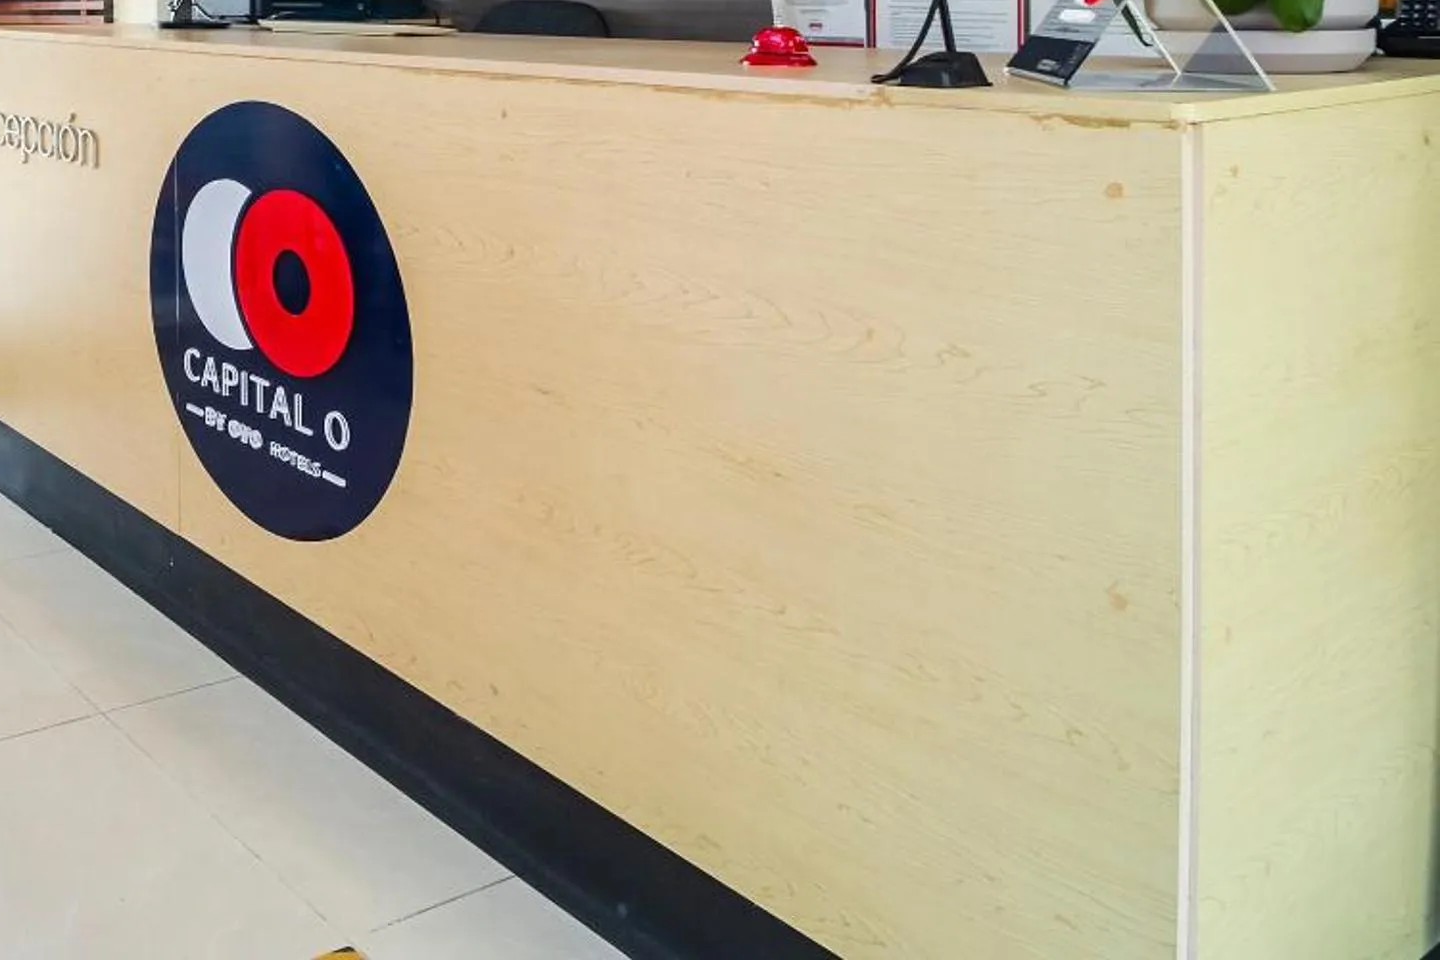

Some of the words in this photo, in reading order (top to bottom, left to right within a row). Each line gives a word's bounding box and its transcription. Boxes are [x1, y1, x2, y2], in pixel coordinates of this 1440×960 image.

[184, 347, 313, 437] CAPITAL
[323, 410, 351, 452] O
[269, 441, 321, 478] HOTELS
